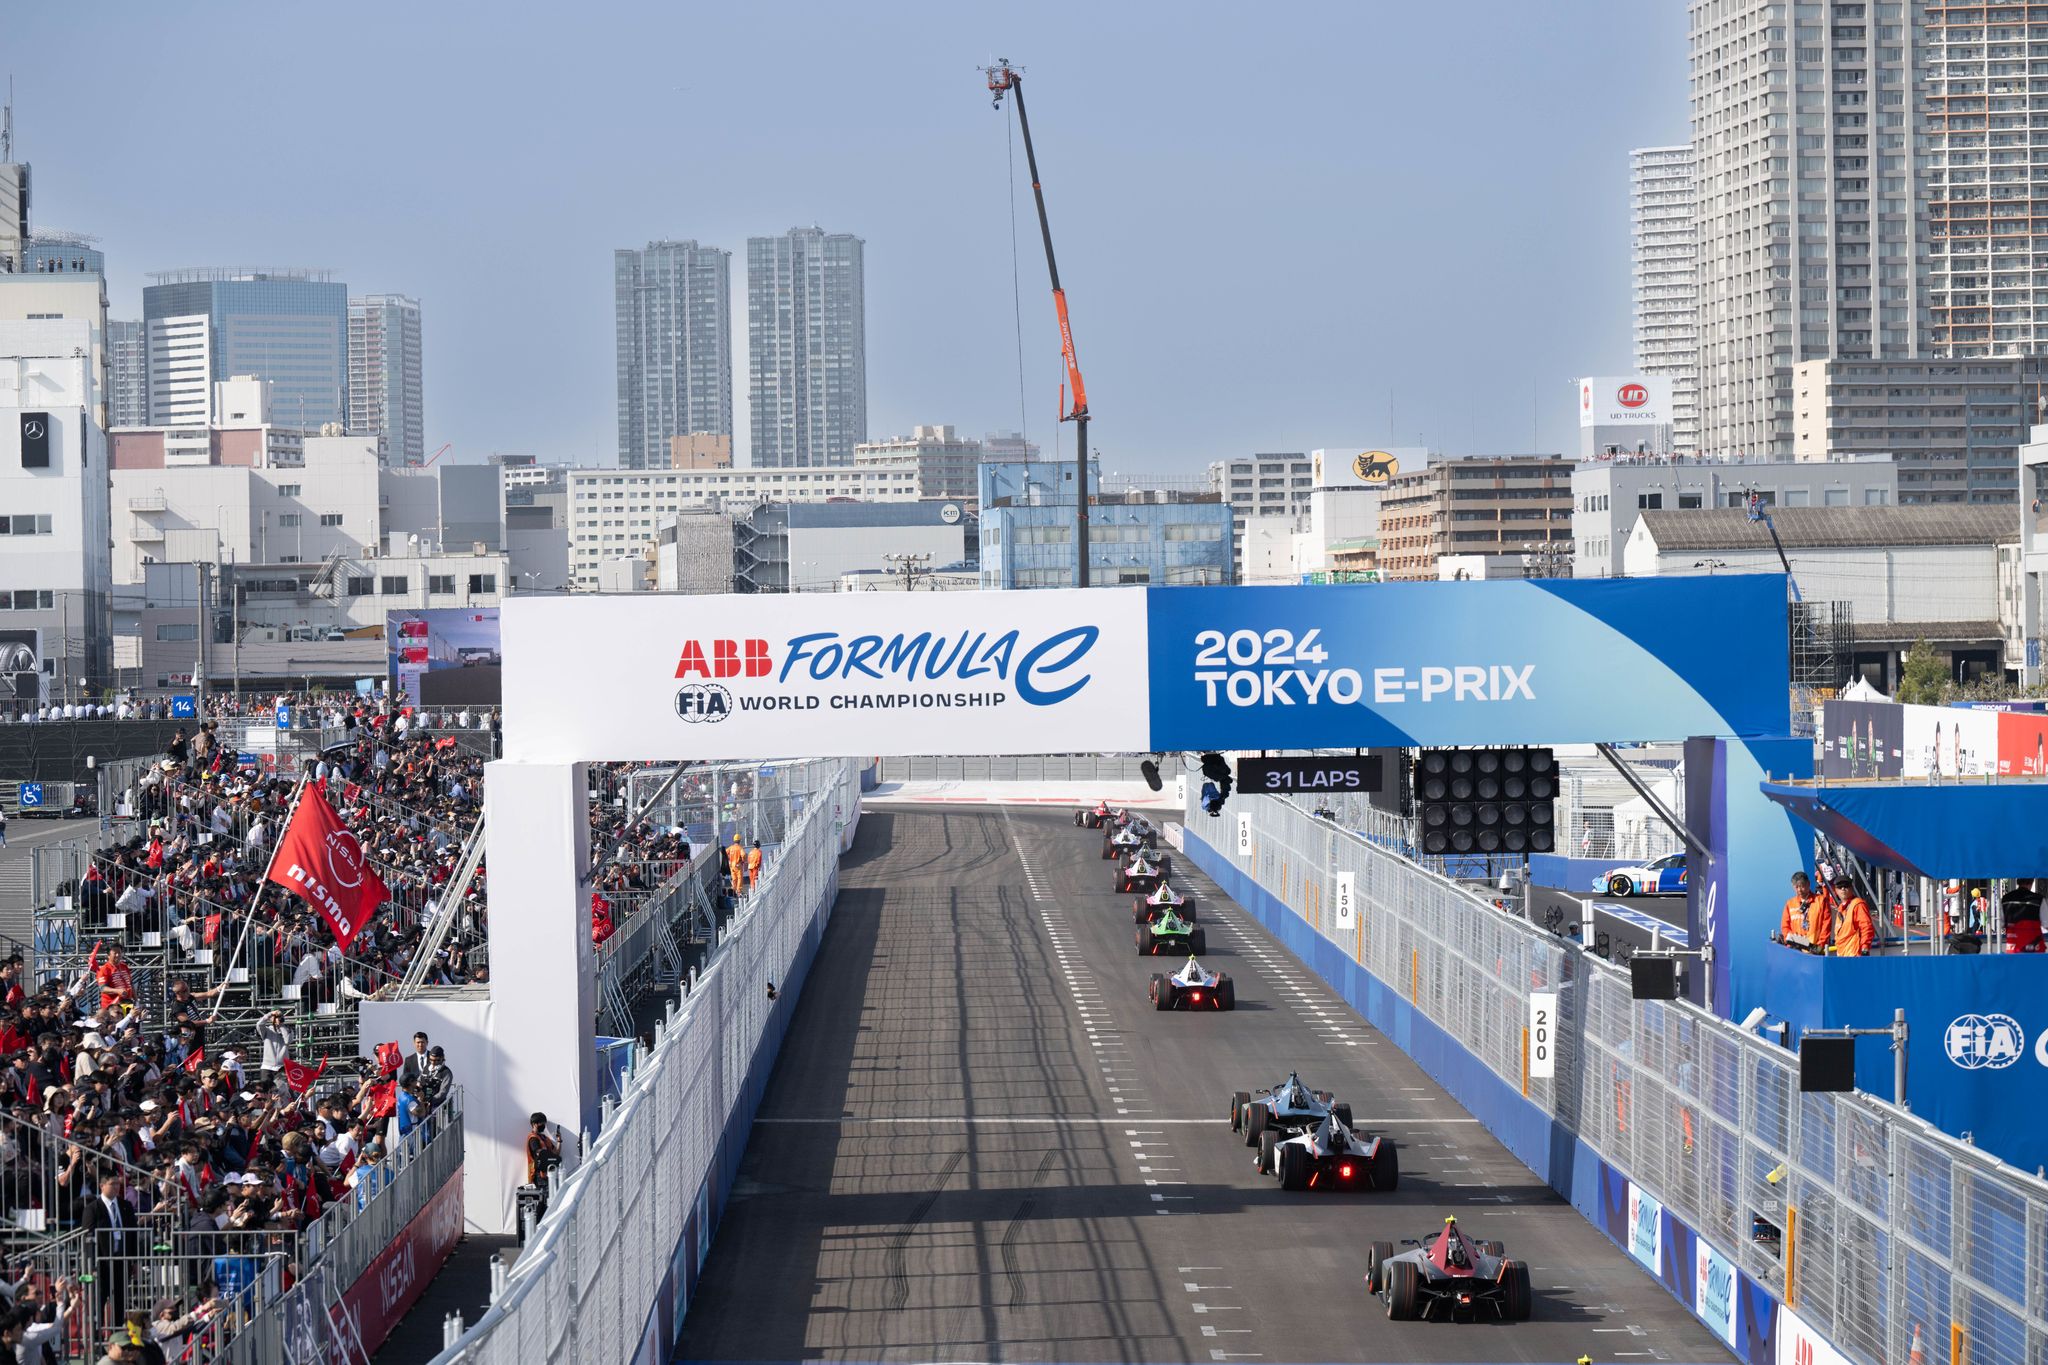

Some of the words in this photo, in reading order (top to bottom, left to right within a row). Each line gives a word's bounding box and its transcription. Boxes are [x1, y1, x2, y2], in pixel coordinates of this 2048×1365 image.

[1618, 389, 1648, 402] UD
[675, 639, 773, 678] ABB
[779, 630, 1020, 683] FORMULA
[1195, 629, 1328, 666] 2024
[740, 695, 820, 710] WORLD
[830, 692, 1006, 709] CHAMPIONSHIP
[1195, 668, 1363, 707] TOKYO
[1374, 664, 1537, 703] E-PRIX
[175, 701, 191, 712] 14
[278, 711, 288, 723] 13
[32, 784, 41, 792] 14
[1265, 771, 1293, 788] 31
[1299, 770, 1360, 788] LAPS
[287, 863, 351, 936] nismo
[1340, 882, 1348, 918] 150
[1536, 1010, 1547, 1060] 200
[380, 1239, 415, 1317] NISSAN
